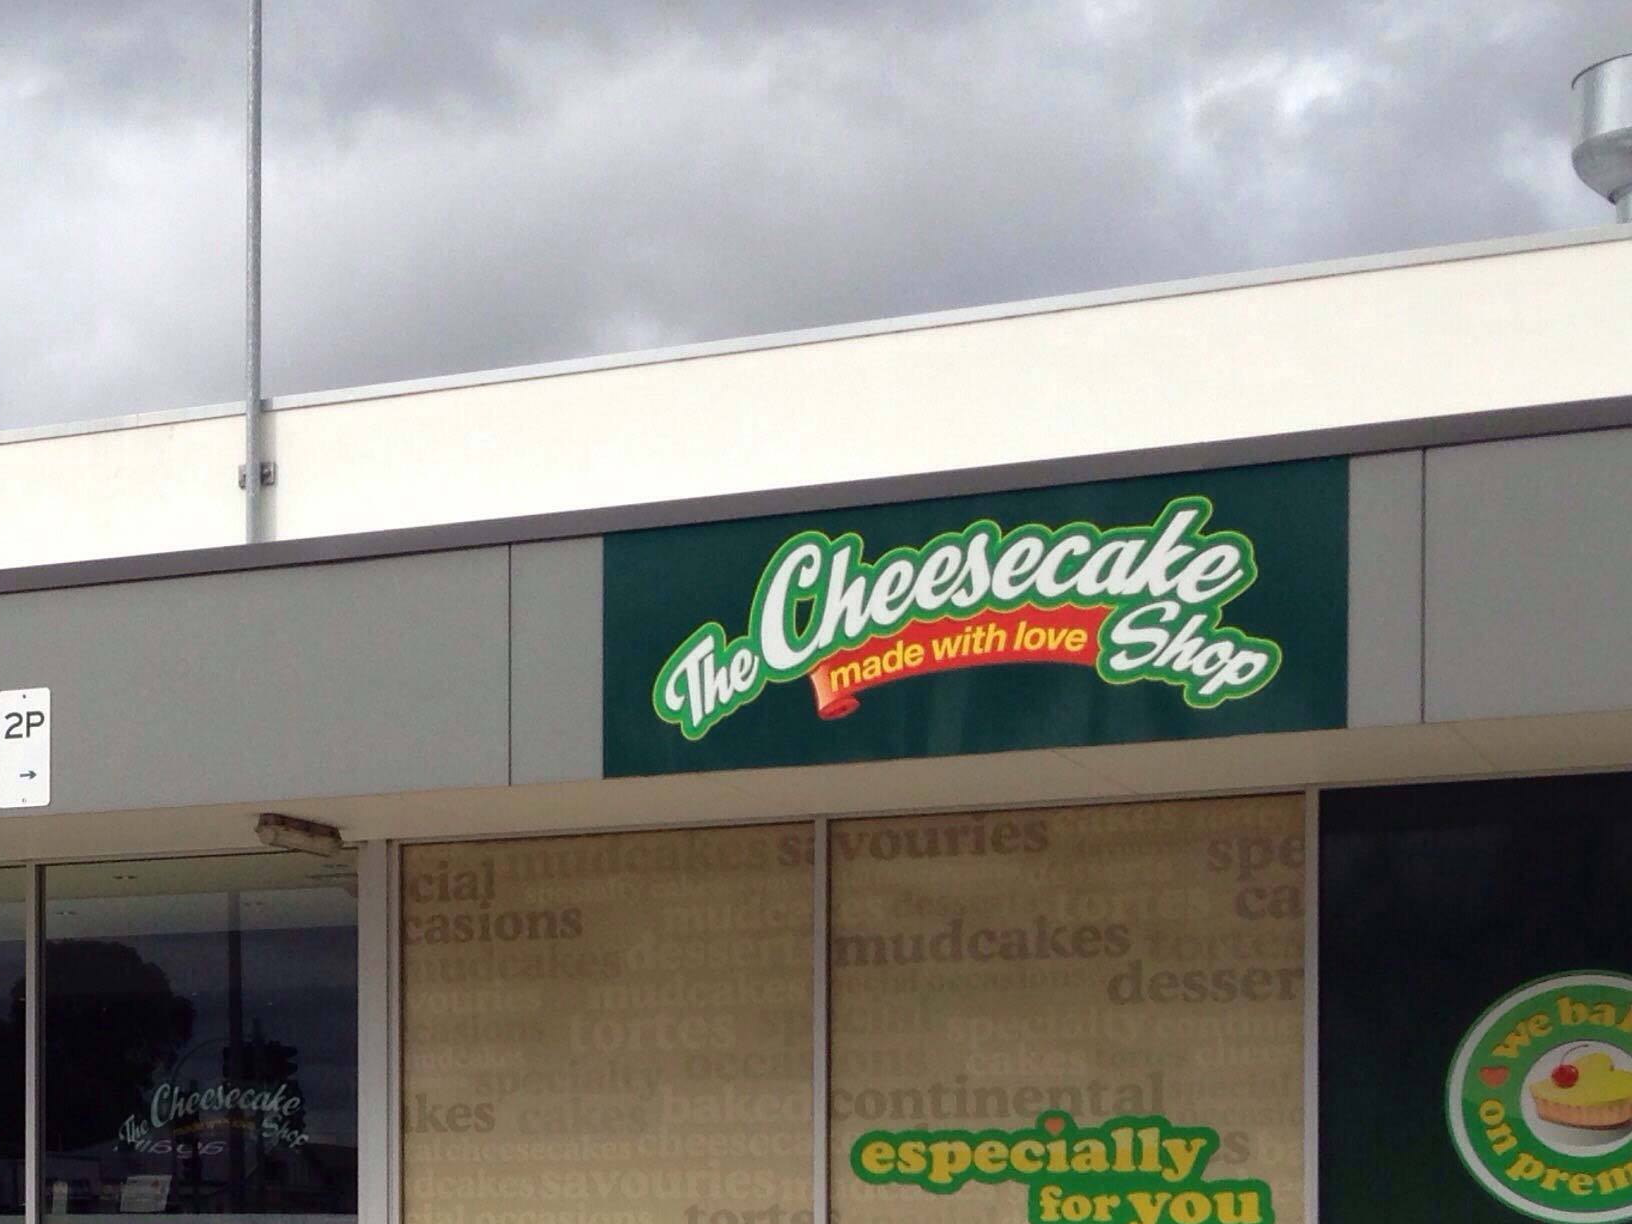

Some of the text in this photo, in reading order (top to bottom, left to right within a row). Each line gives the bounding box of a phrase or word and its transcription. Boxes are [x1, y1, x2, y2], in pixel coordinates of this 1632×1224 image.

[665, 509, 1244, 728] The Cheesecake
[830, 619, 1088, 692] made with love
[1108, 604, 1268, 696] Shop
[4, 711, 45, 739] 2P
[833, 915, 1131, 968] mudcakes
[1492, 1012, 1553, 1058] we
[118, 1083, 302, 1145] The Cheesecake
[262, 1114, 309, 1148] Shop
[405, 1093, 496, 1133] kes
[1479, 1099, 1518, 1156] on
[862, 1126, 1207, 1183] especially
[1039, 1185, 1122, 1222] for
